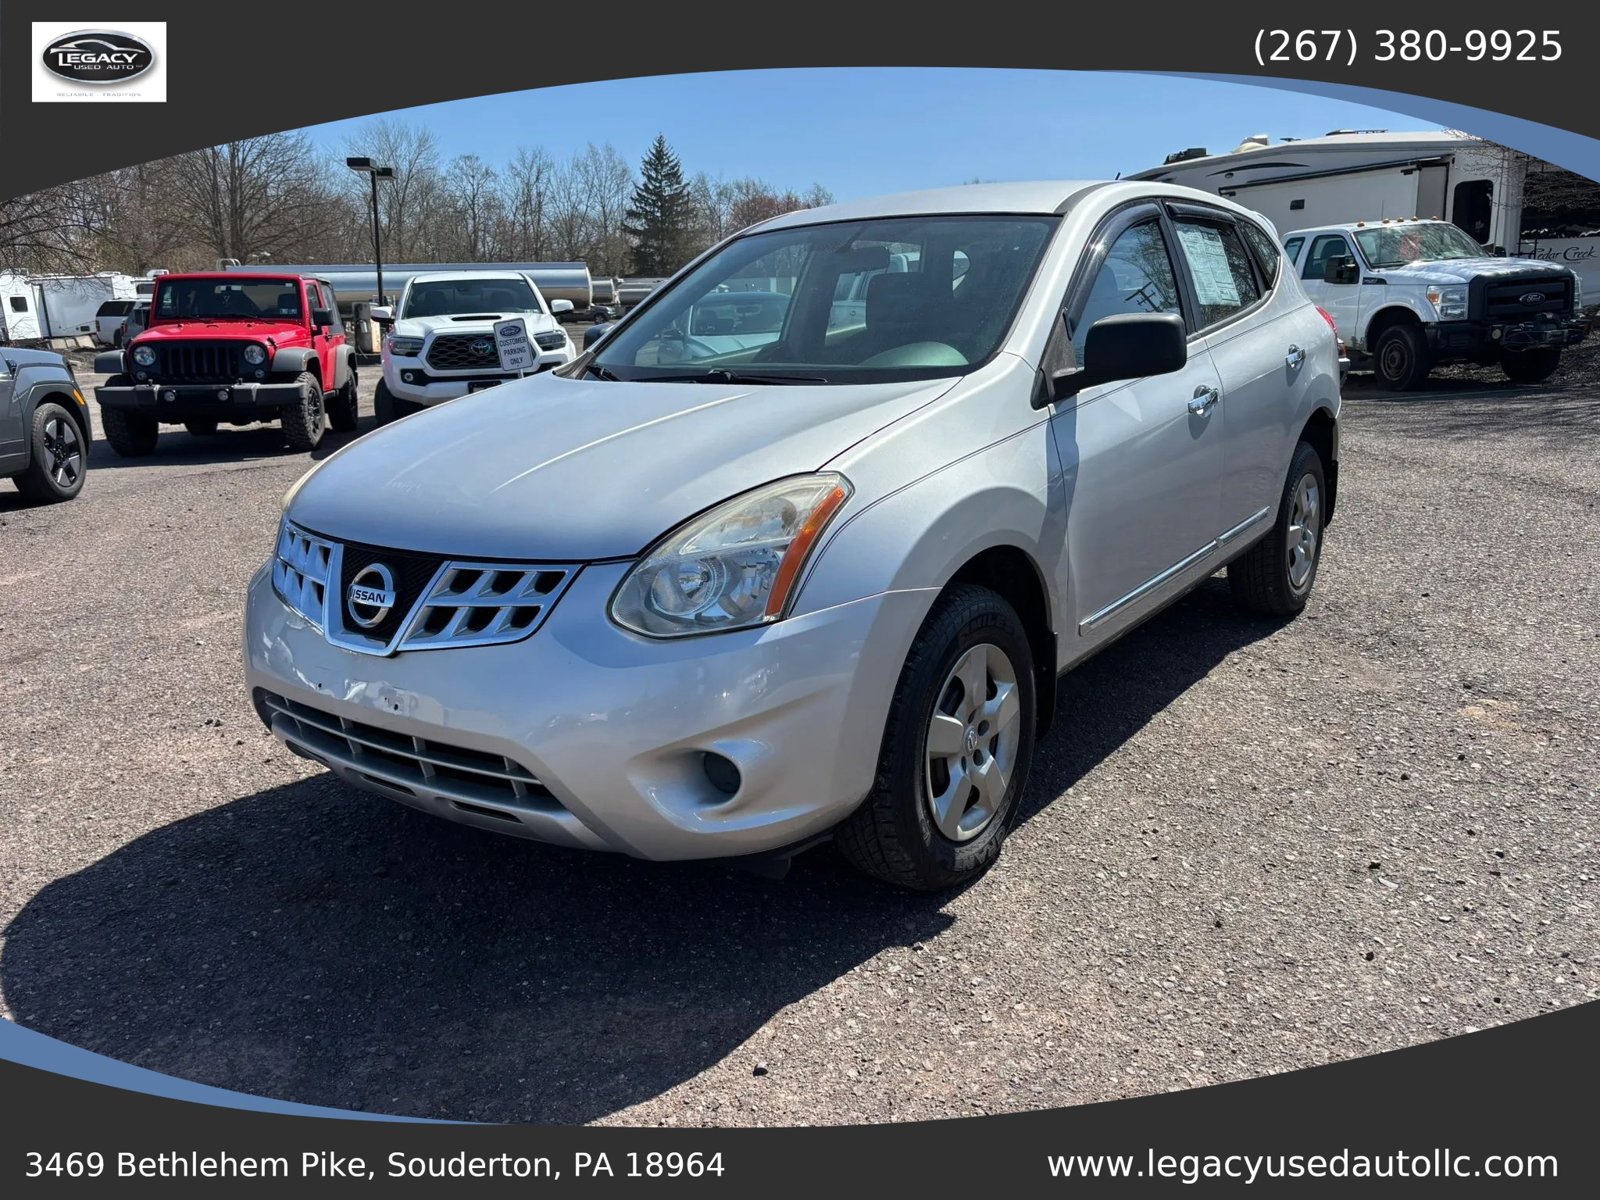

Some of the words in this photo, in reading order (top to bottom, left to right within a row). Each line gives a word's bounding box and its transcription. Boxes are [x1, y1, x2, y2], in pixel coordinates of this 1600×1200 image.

[1563, 246, 1597, 261] Creek
[1525, 294, 1542, 303] Ford
[499, 337, 527, 347] CUSTOMER
[503, 347, 526, 355] PARKING
[510, 357, 523, 365] ONLY
